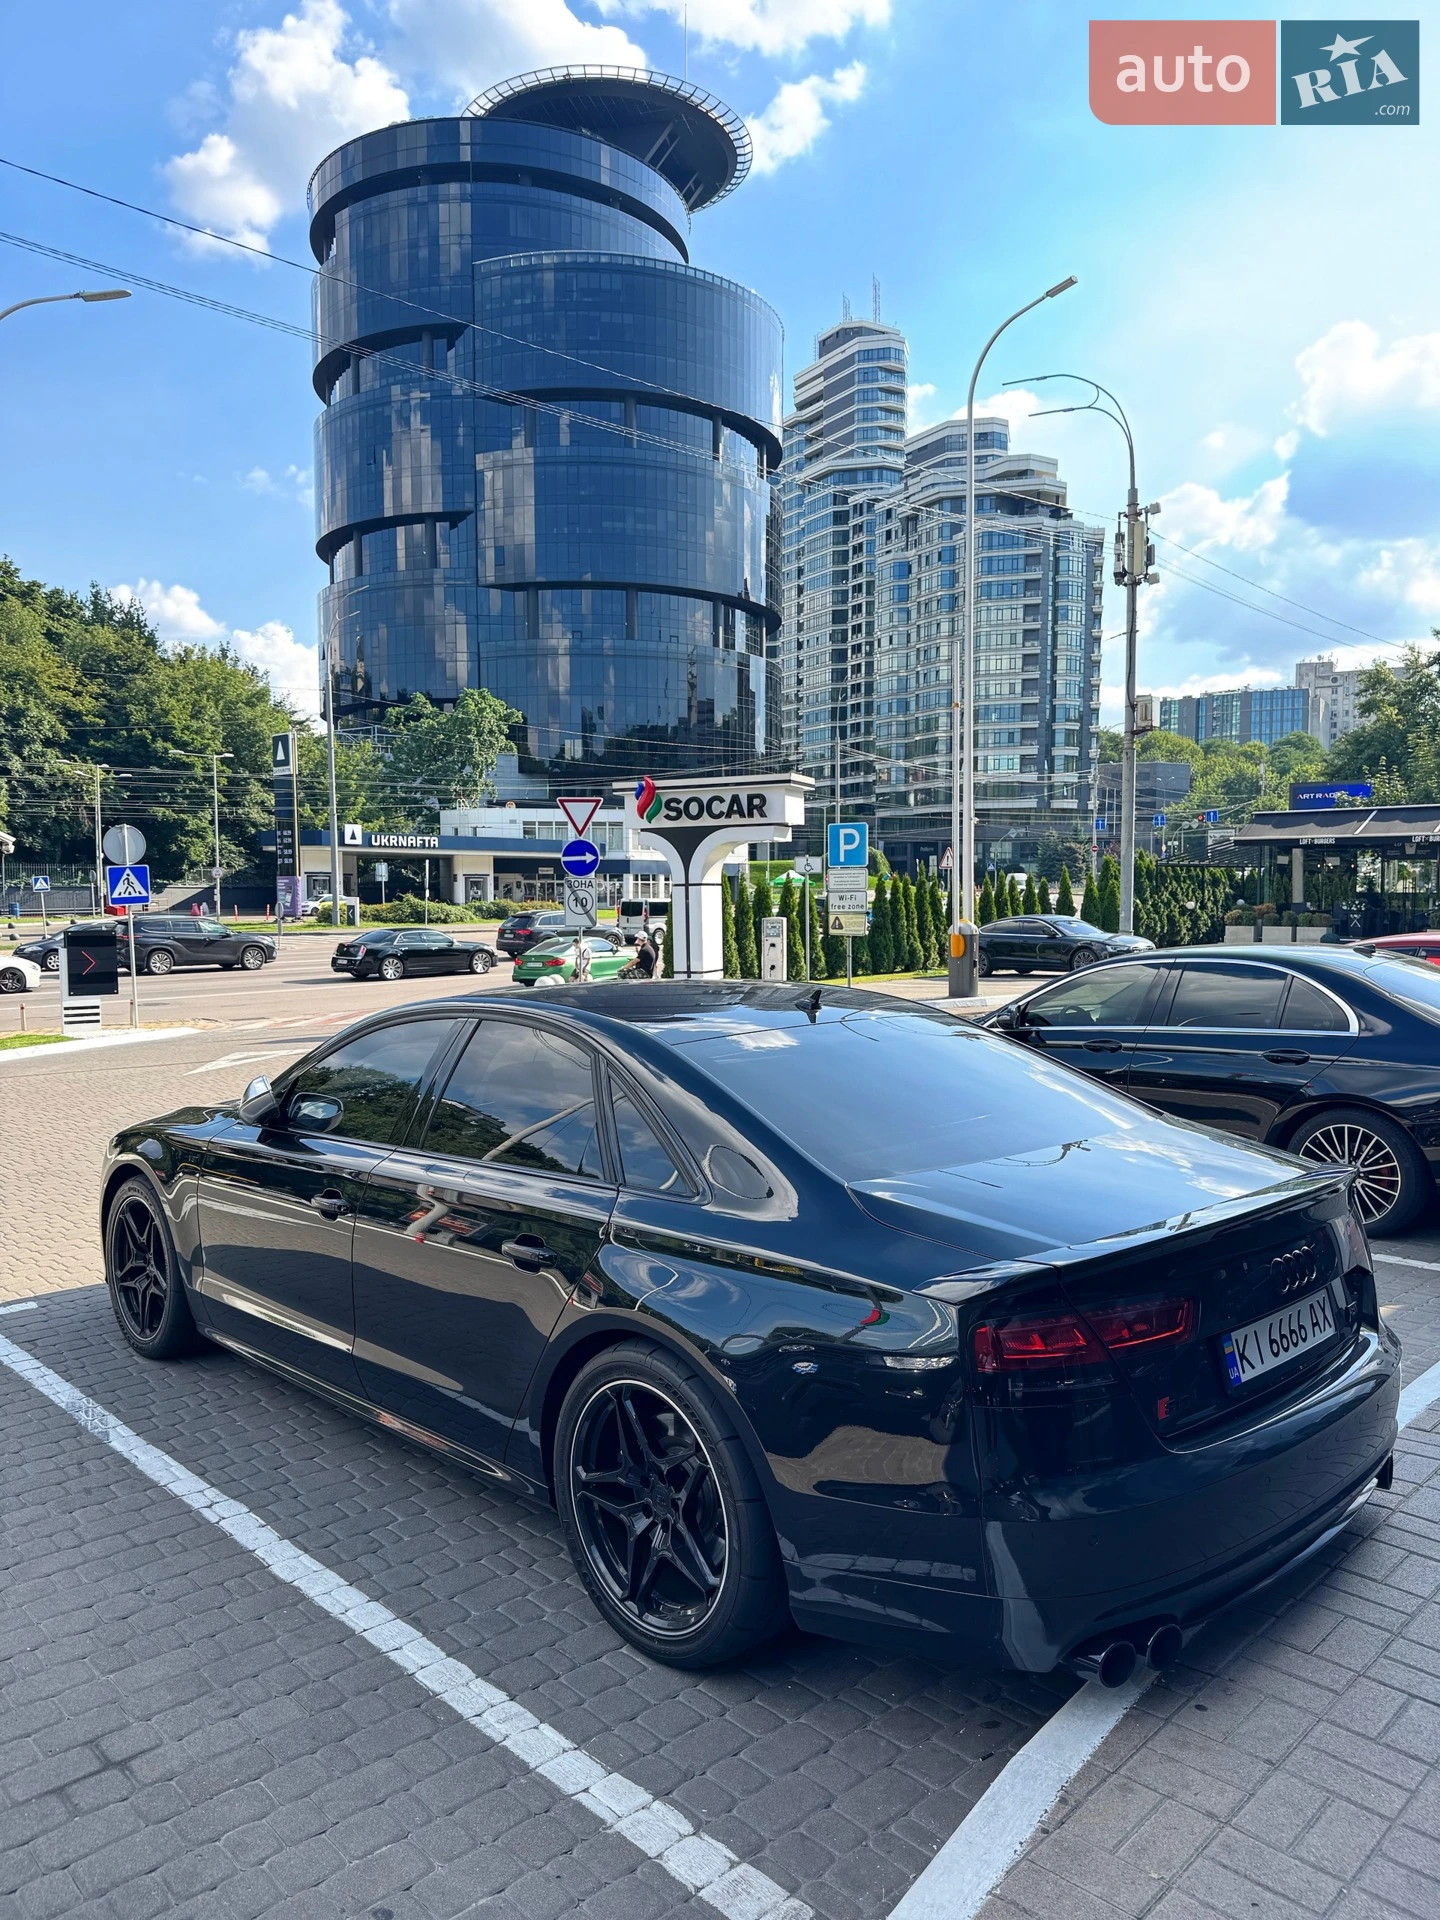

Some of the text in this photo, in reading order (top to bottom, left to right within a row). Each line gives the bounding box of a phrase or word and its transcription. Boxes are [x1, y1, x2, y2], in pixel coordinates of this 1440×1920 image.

[663, 793, 768, 822] SOCAR
[371, 834, 439, 848] UKRNAFTA
[839, 828, 860, 863] P
[566, 880, 594, 889] ЗОНА
[572, 896, 588, 908] 10
[1268, 1308, 1308, 1358] 6666
[1308, 1294, 1333, 1338] AX
[1228, 1366, 1240, 1380] UA
